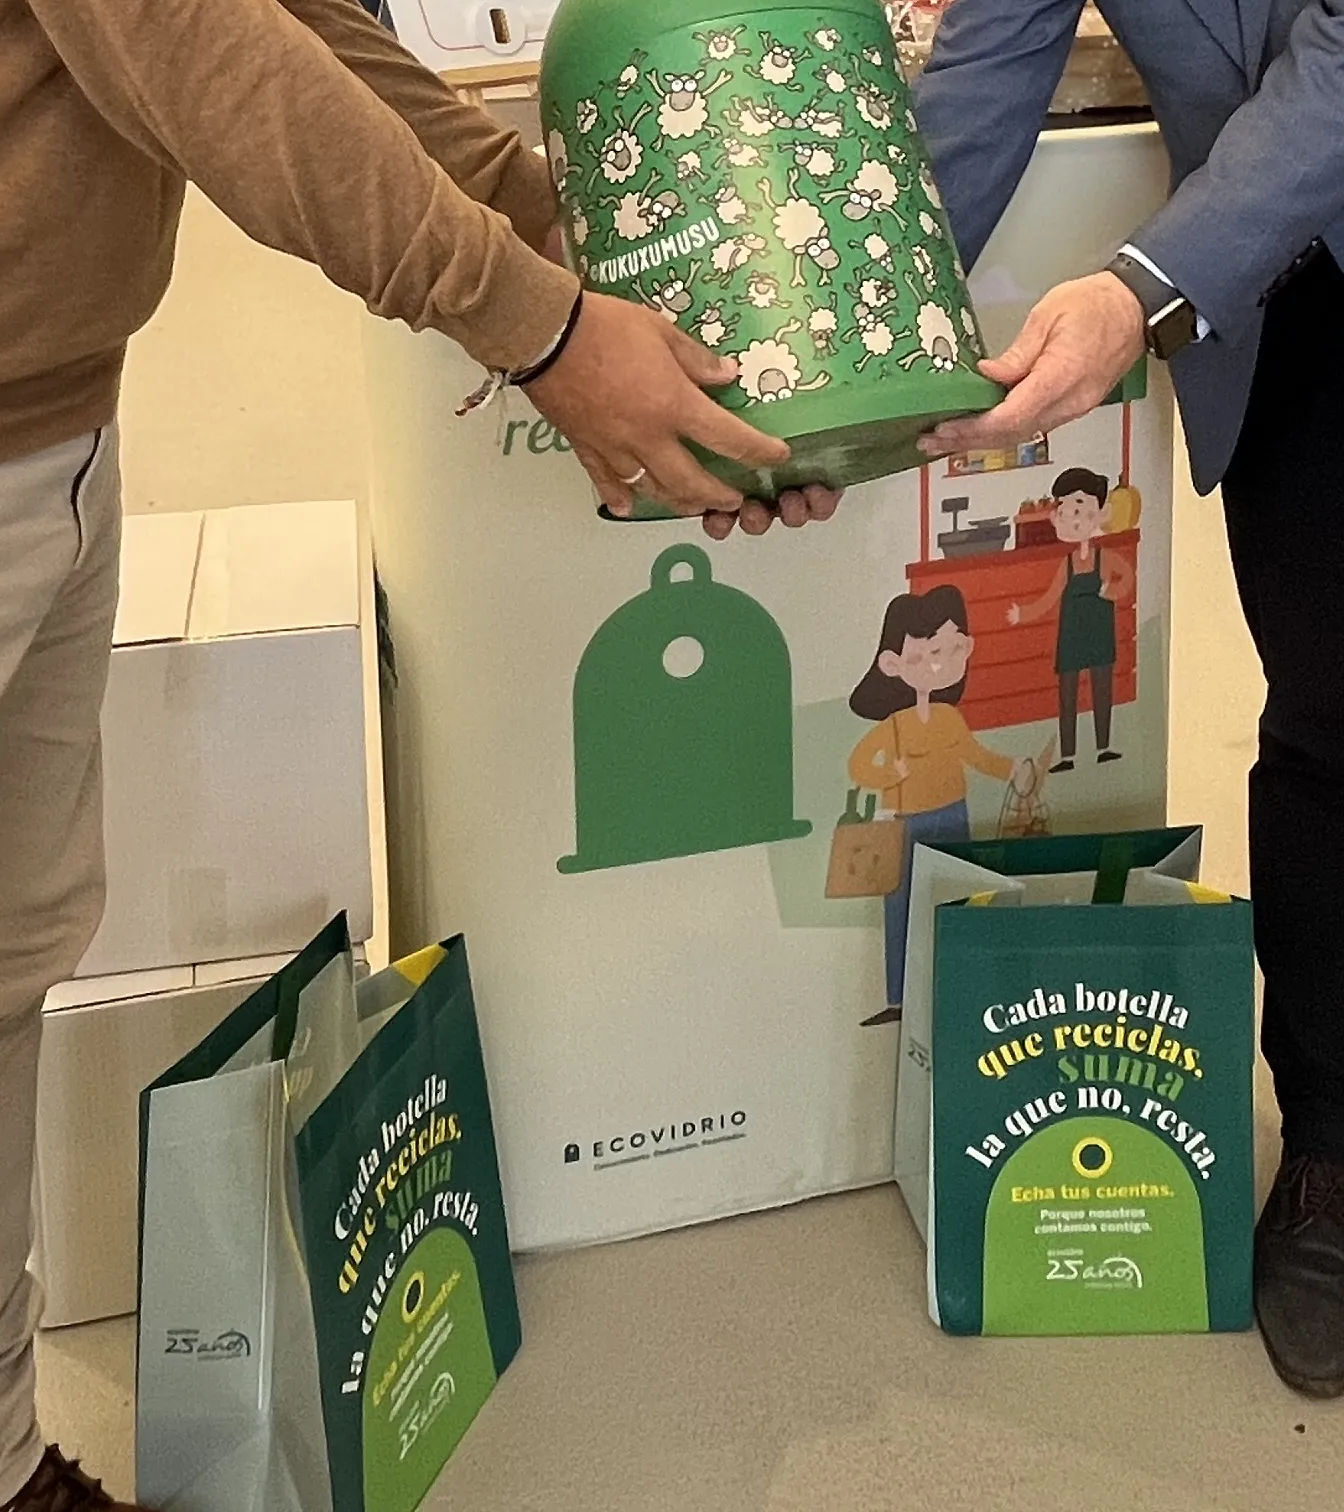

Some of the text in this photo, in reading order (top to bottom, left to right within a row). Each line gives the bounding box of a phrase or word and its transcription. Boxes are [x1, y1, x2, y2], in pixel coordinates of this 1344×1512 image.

[983, 982, 1190, 1034] Cada botella
[978, 1032, 1045, 1080] que
[1057, 1053, 1185, 1103] suma
[335, 1074, 448, 1240] Cada botella
[592, 1109, 748, 1159] ECOVIDRIO
[965, 1133, 1007, 1170] la
[1005, 1090, 1069, 1138] que
[1139, 1097, 1216, 1180] resta.
[385, 1149, 453, 1239] suma
[1010, 1182, 1176, 1203] Echa tus cuentas.
[1040, 1206, 1146, 1222] Porque nosotros
[338, 1206, 377, 1294] que
[1034, 1222, 1098, 1235] contamos
[342, 1351, 365, 1394] la
[361, 1251, 397, 1335] que
[433, 1190, 480, 1237] resta.
[1046, 1259, 1084, 1280] 25
[165, 1337, 198, 1354] 25
